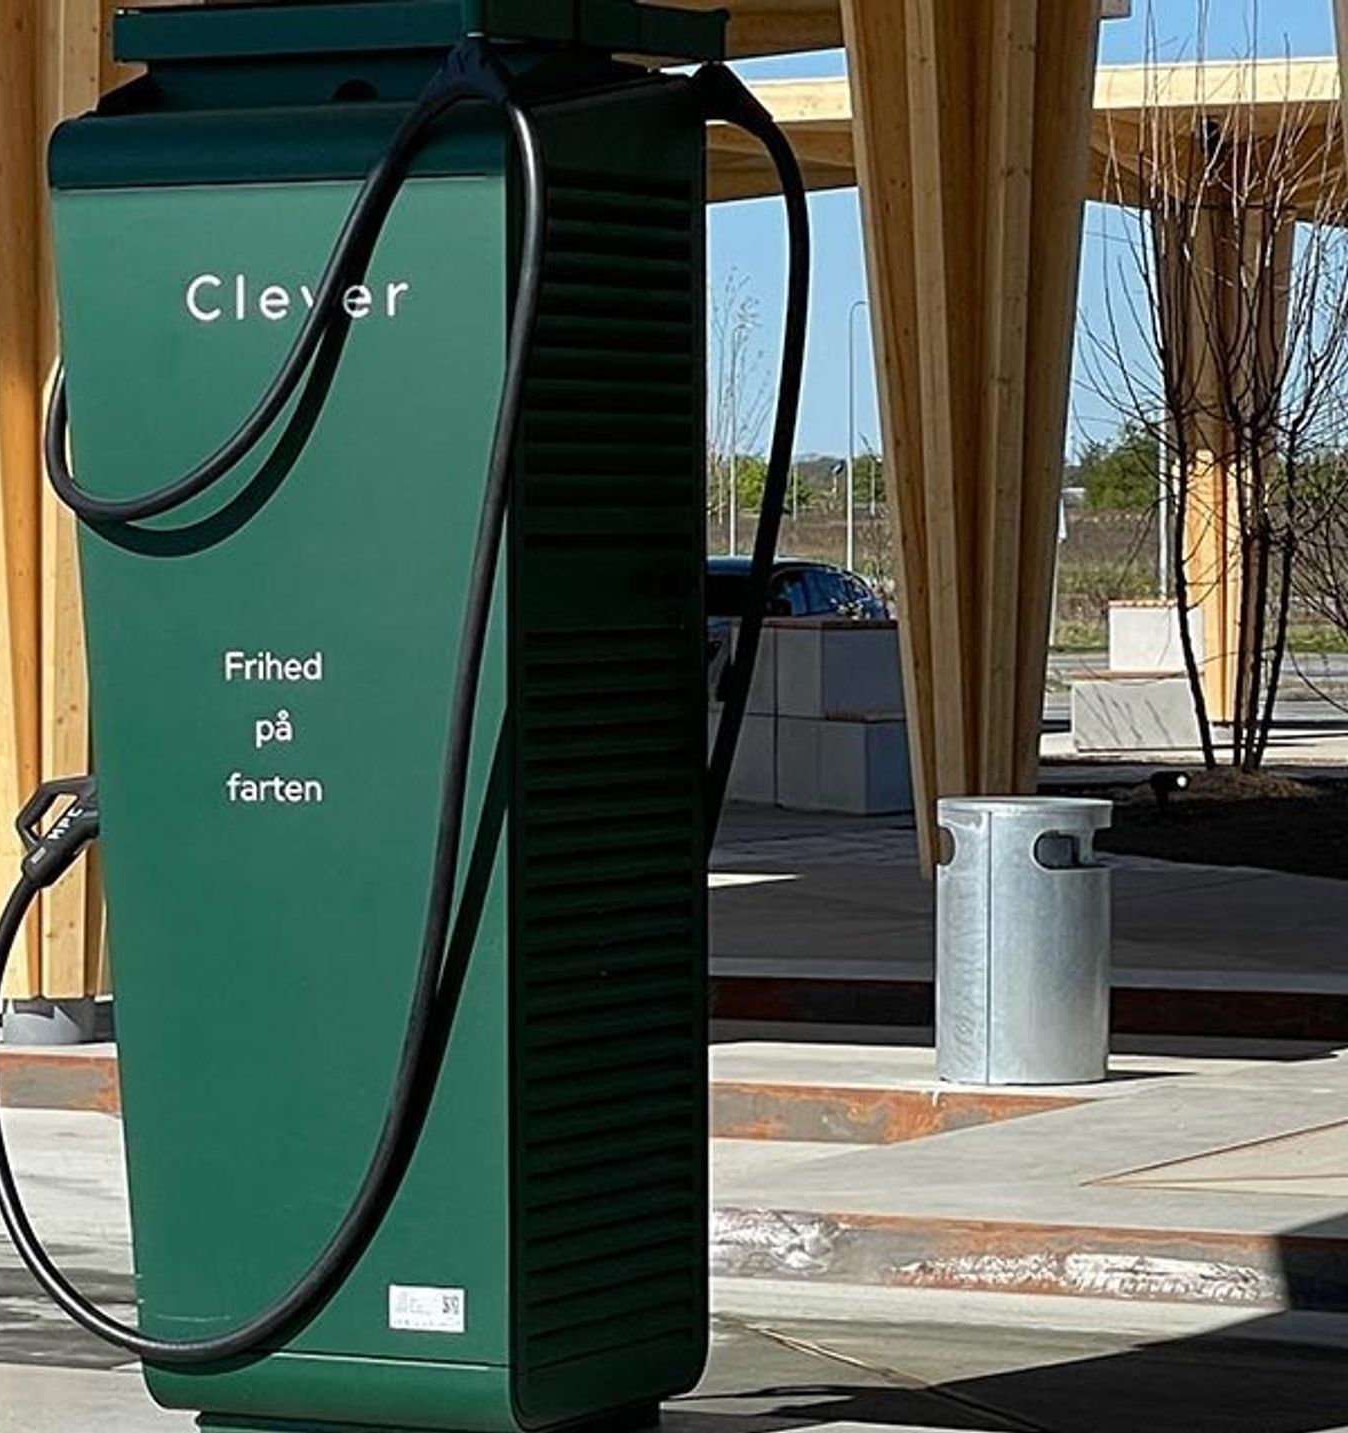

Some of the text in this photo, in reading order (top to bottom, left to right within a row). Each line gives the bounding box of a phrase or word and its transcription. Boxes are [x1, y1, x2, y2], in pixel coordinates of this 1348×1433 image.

[225, 651, 322, 681] Frihed
[255, 709, 293, 748] på
[226, 772, 323, 802] farten
